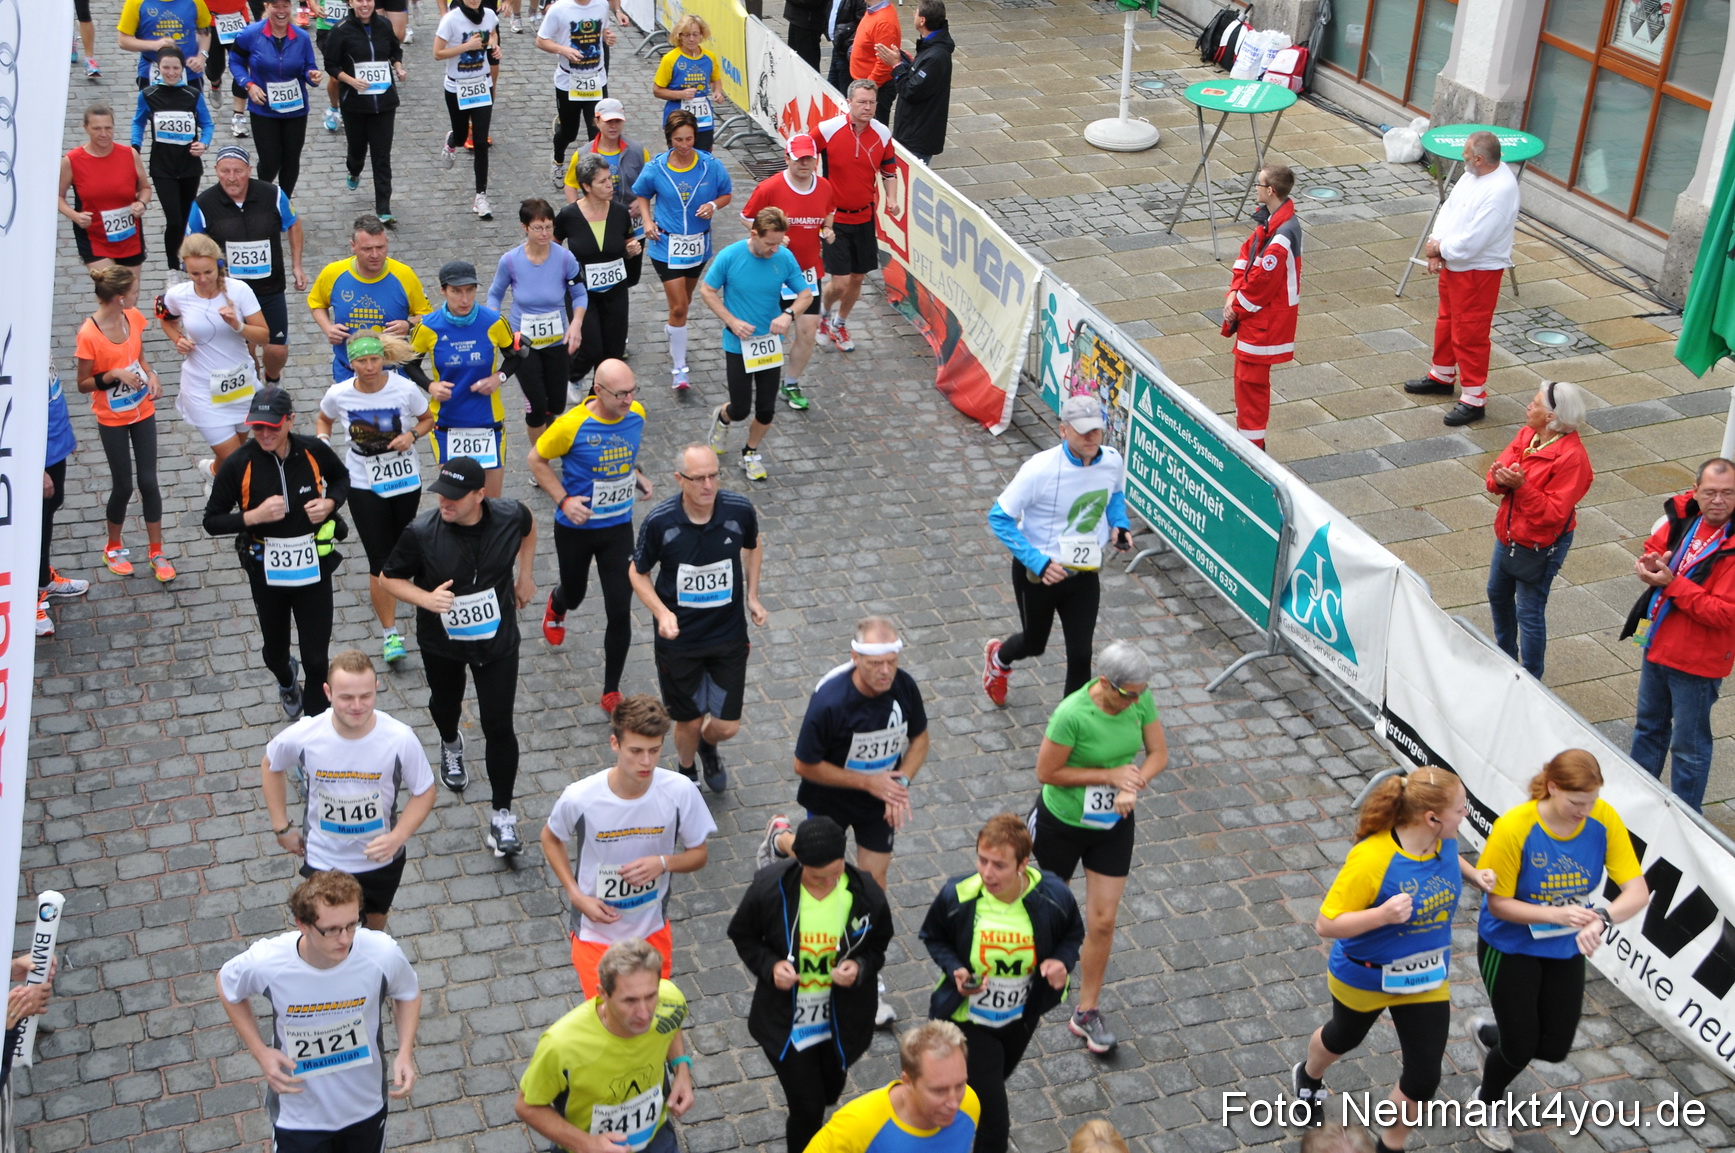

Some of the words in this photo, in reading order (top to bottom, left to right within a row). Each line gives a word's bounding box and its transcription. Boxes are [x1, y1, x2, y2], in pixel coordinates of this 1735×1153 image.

[359, 70, 386, 82] 2697
[576, 79, 595, 90] 219
[272, 88, 300, 102] 2504
[160, 120, 191, 132] 2336
[104, 213, 135, 232] 2250
[232, 250, 267, 265] 2534
[673, 242, 701, 255] 2291
[591, 268, 623, 286] 2386
[530, 322, 555, 337] 151
[750, 340, 776, 357] 260
[220, 374, 246, 393] 633
[453, 438, 490, 455] 2867
[1156, 404, 1224, 472] Event-Leit-Systeme
[372, 458, 413, 482] 2406
[1134, 425, 1164, 463] Mehr
[1166, 453, 1225, 522] Sicherheit
[383, 480, 408, 491] Claudia
[598, 485, 633, 505] 2426
[1131, 451, 1149, 480] für
[1151, 467, 1167, 496] Ihr
[1169, 485, 1207, 533] Event!
[1129, 485, 1146, 509] Miet
[1146, 502, 1153, 516] &
[1152, 508, 1178, 540] Service
[1178, 531, 1195, 556] Line:
[1195, 548, 1219, 578] 09181
[1219, 569, 1238, 597] 6352
[270, 547, 314, 568] 3379
[1072, 547, 1090, 564] 22
[683, 573, 728, 592] 2034
[693, 593, 719, 602] Johann
[448, 602, 494, 627] 3380
[1312, 639, 1336, 664] Service
[1337, 658, 1358, 681] GmbH
[856, 739, 900, 759] 2315
[338, 796, 370, 805] Neumarkt
[324, 802, 377, 822] 2146
[337, 825, 365, 833] Marco
[30, 932, 52, 982] BMW
[1404, 974, 1430, 987] Agnes
[313, 1023, 351, 1036] Neumarkt
[295, 1029, 359, 1058] 2121
[302, 1051, 360, 1070] Maximilian
[599, 1101, 657, 1134] 3414
